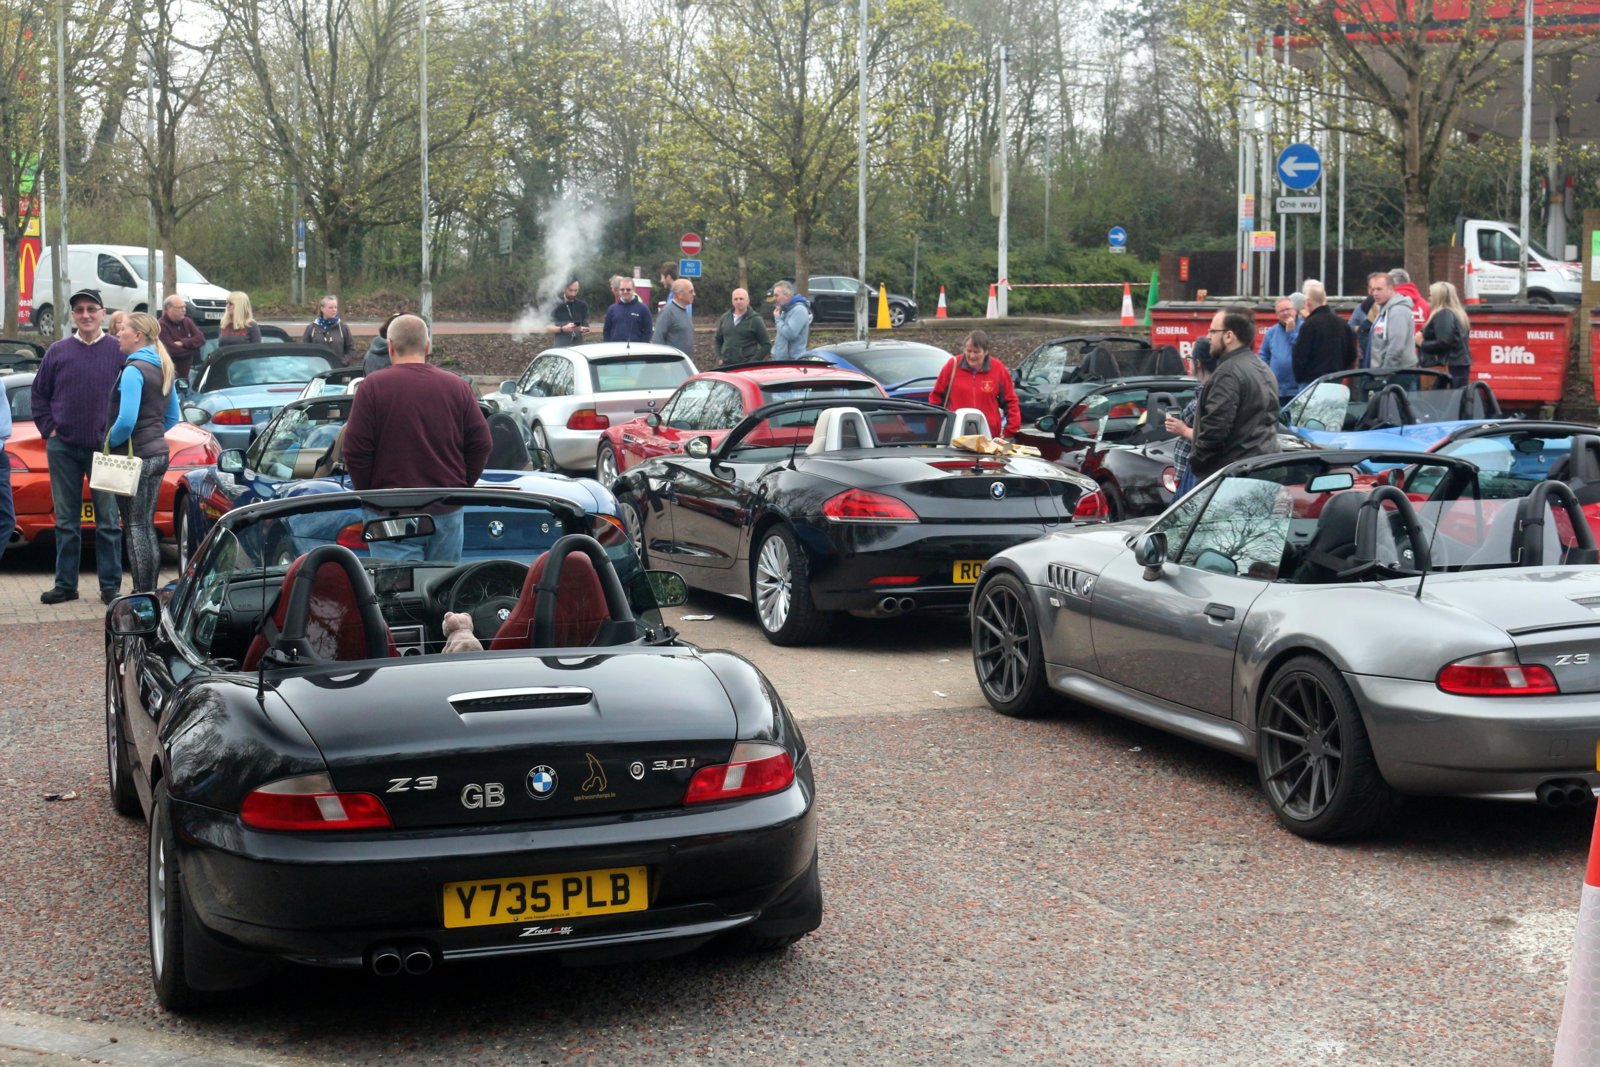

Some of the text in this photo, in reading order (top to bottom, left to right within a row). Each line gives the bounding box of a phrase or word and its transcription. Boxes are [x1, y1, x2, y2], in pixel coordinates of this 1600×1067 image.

[1156, 326, 1189, 335] GENERAL
[1469, 330, 1554, 340] GENERAL WASTE
[1491, 345, 1535, 364] Biffa
[1555, 654, 1590, 666] Z3
[652, 758, 696, 771] 3.0i
[386, 776, 438, 793] Z3
[461, 782, 506, 810] GB
[456, 873, 630, 919] Y735 PLB
